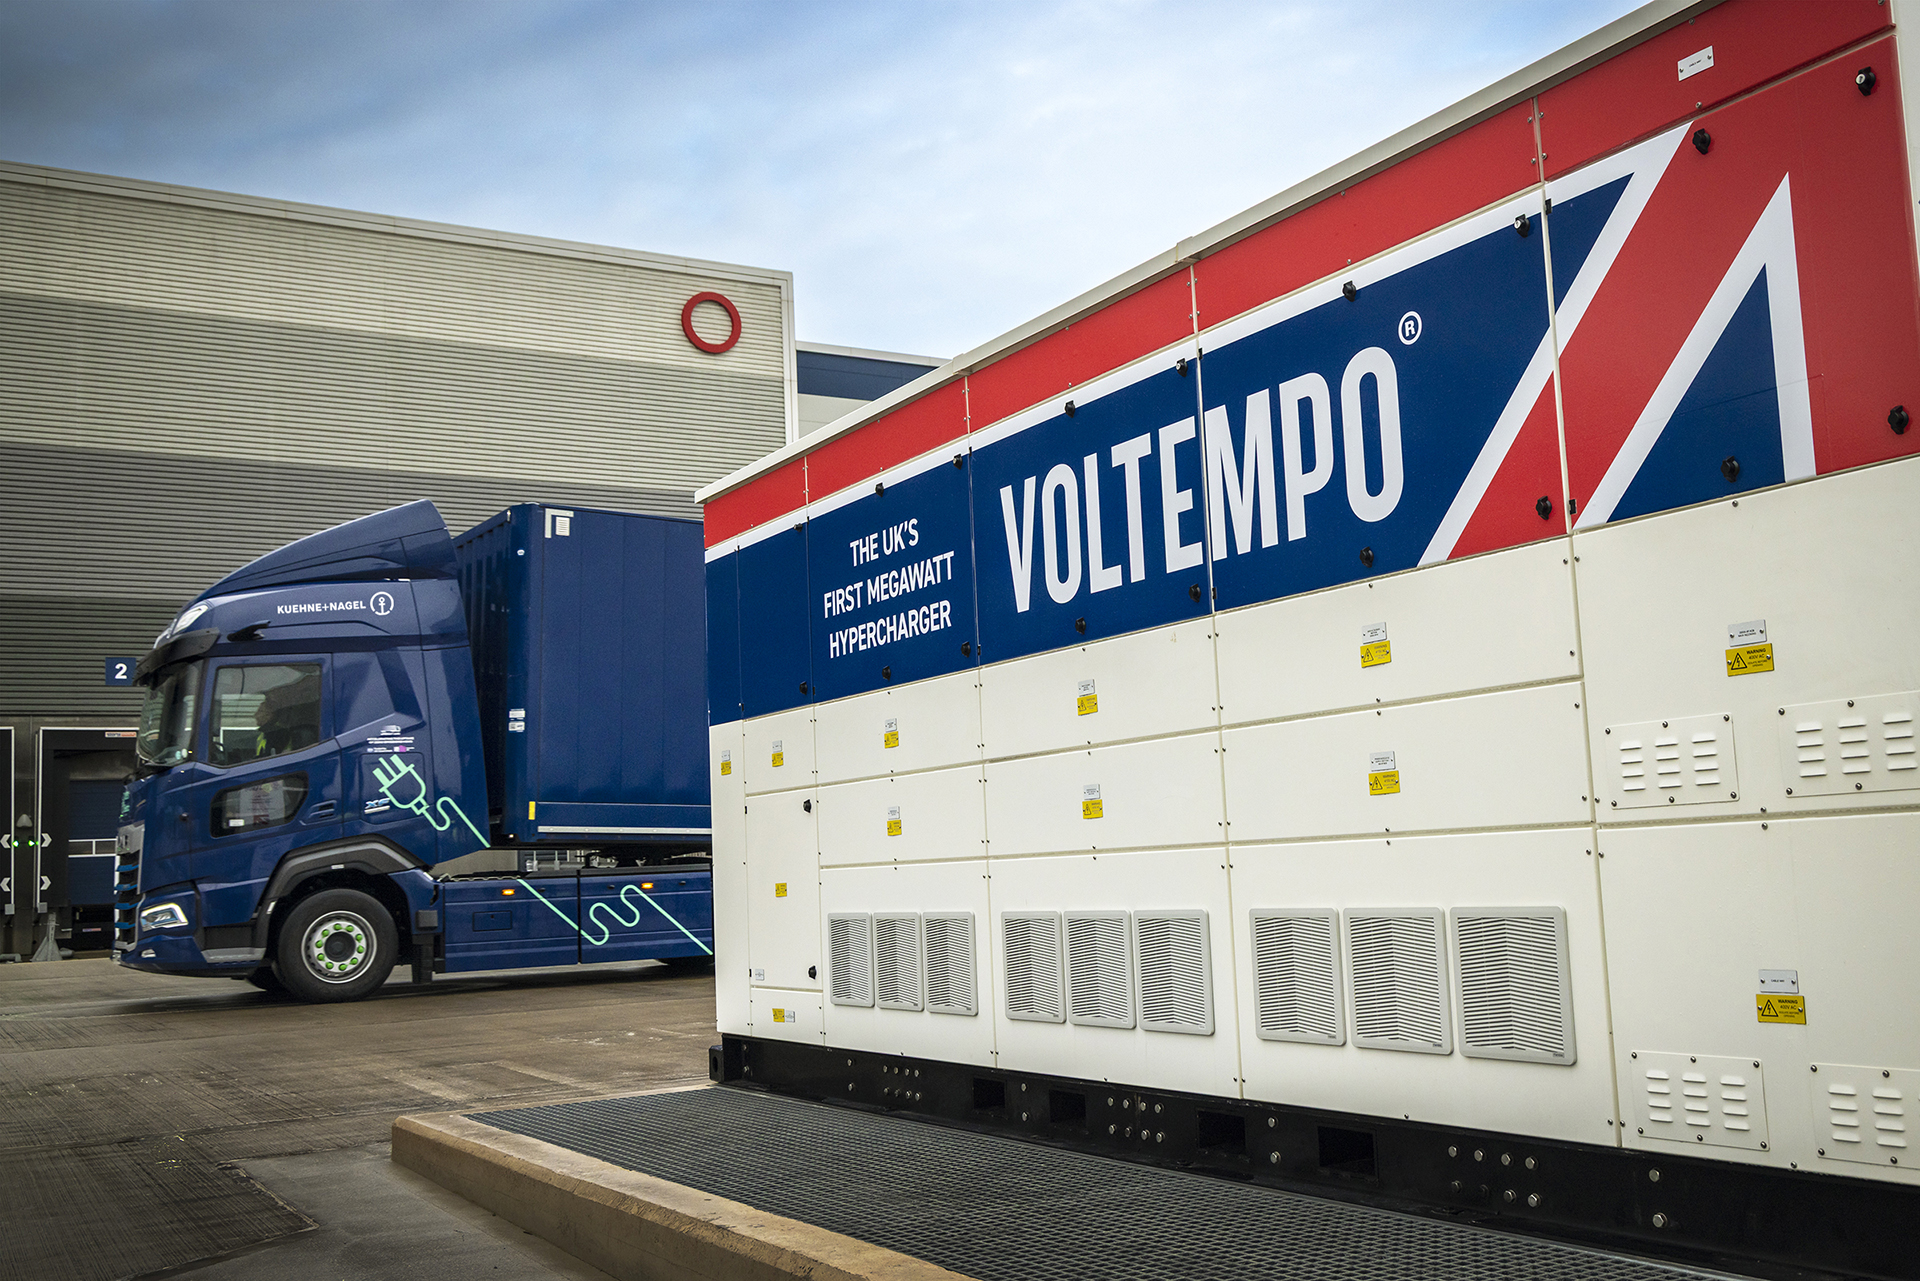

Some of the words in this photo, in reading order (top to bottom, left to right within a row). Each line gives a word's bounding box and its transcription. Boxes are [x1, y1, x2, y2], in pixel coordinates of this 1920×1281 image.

[1000, 346, 1404, 613] VOLTEMPO
[849, 532, 879, 567] THE
[882, 518, 919, 556] UK'S
[277, 601, 366, 614] KUEHNE+NAGEL
[824, 581, 863, 619] FIRST
[867, 550, 955, 605] MEGAWATT
[829, 599, 952, 659] HYPERCHARGER
[114, 663, 128, 679] 2
